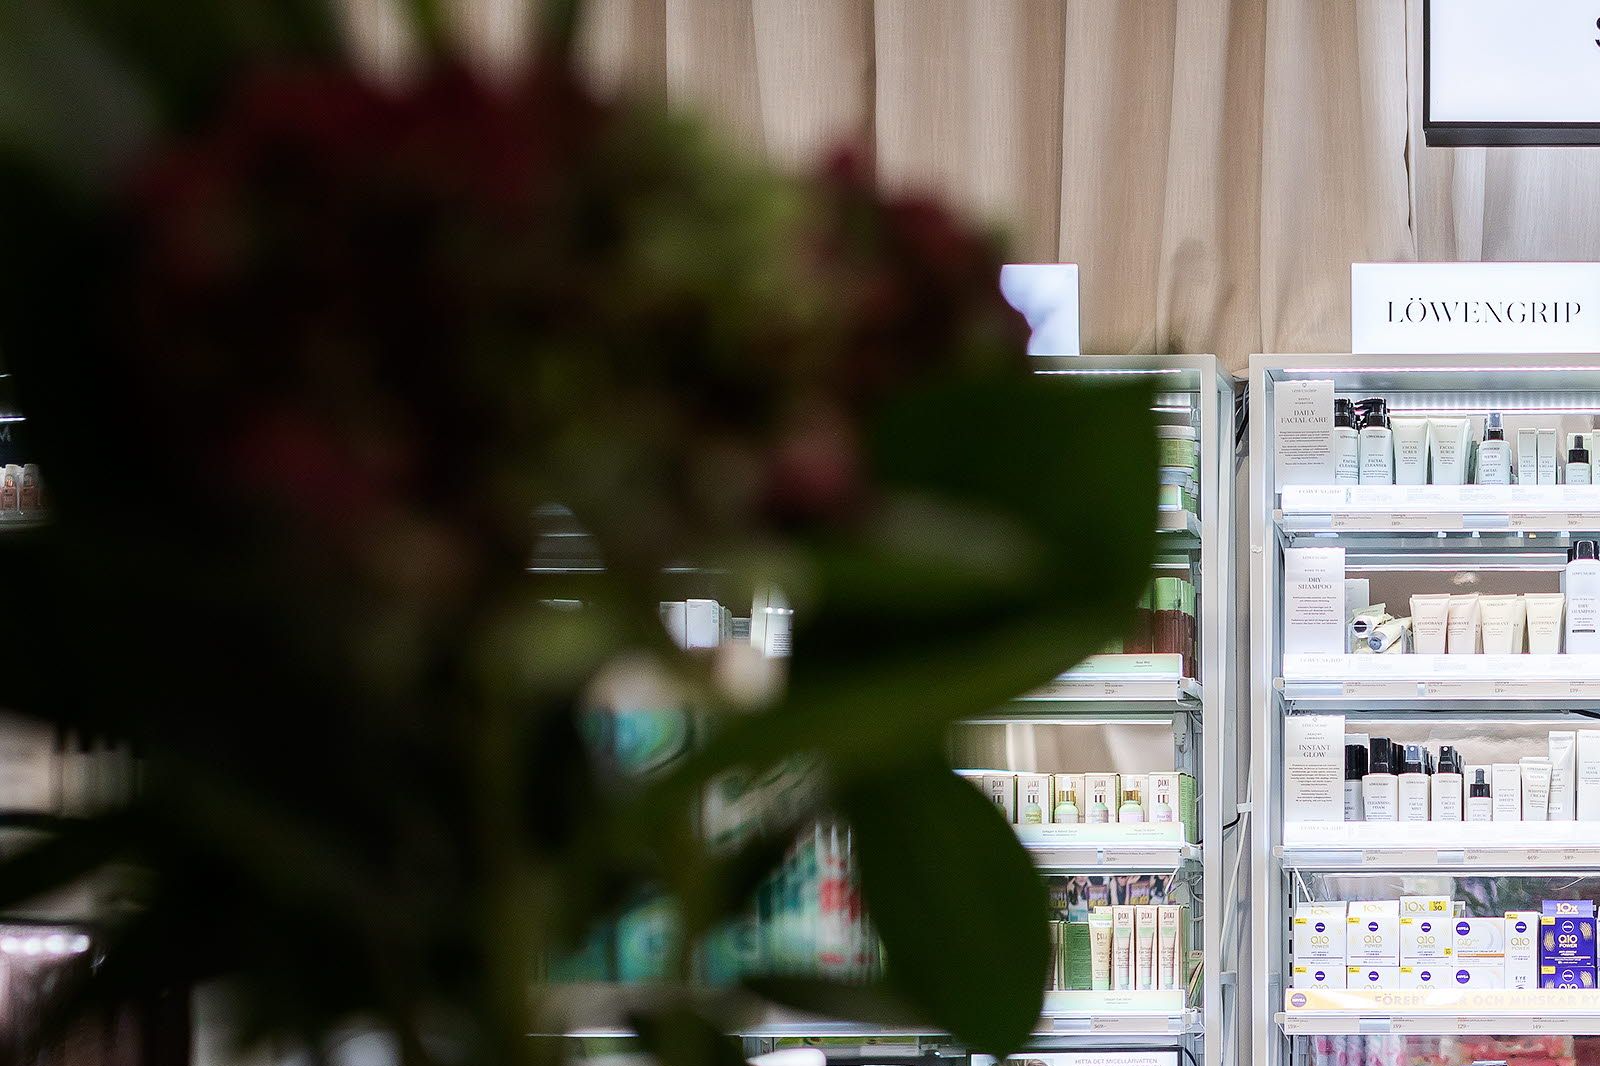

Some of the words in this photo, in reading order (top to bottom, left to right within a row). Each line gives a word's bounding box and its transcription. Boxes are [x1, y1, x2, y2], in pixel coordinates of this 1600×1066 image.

[1386, 297, 1582, 324] LÖWENGRIP
[1556, 904, 1579, 913] 10x
[1311, 936, 1329, 945] Q10
[1364, 935, 1382, 944] Q10
[1558, 934, 1578, 944] Q10
